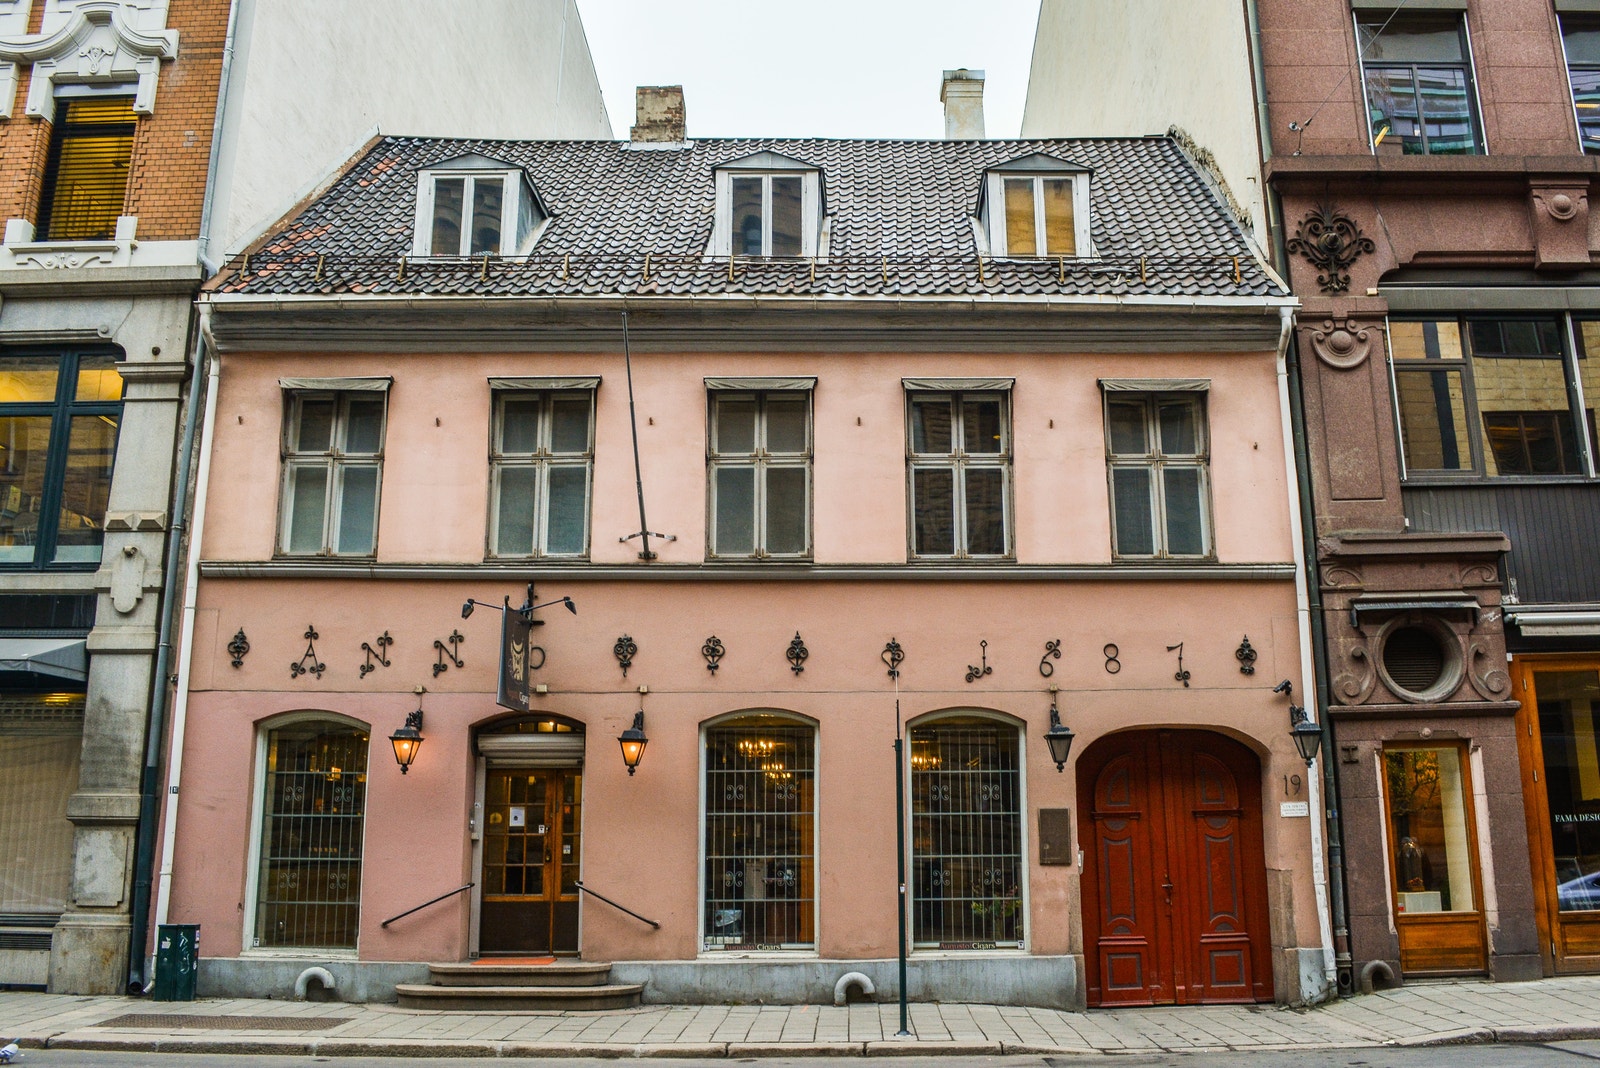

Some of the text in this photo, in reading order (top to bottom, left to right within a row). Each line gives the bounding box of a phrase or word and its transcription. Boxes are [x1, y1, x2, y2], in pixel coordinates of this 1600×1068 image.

[965, 639, 1191, 687] 1687
[1283, 774, 1301, 796] 19
[1555, 814, 1578, 823] FAMA
